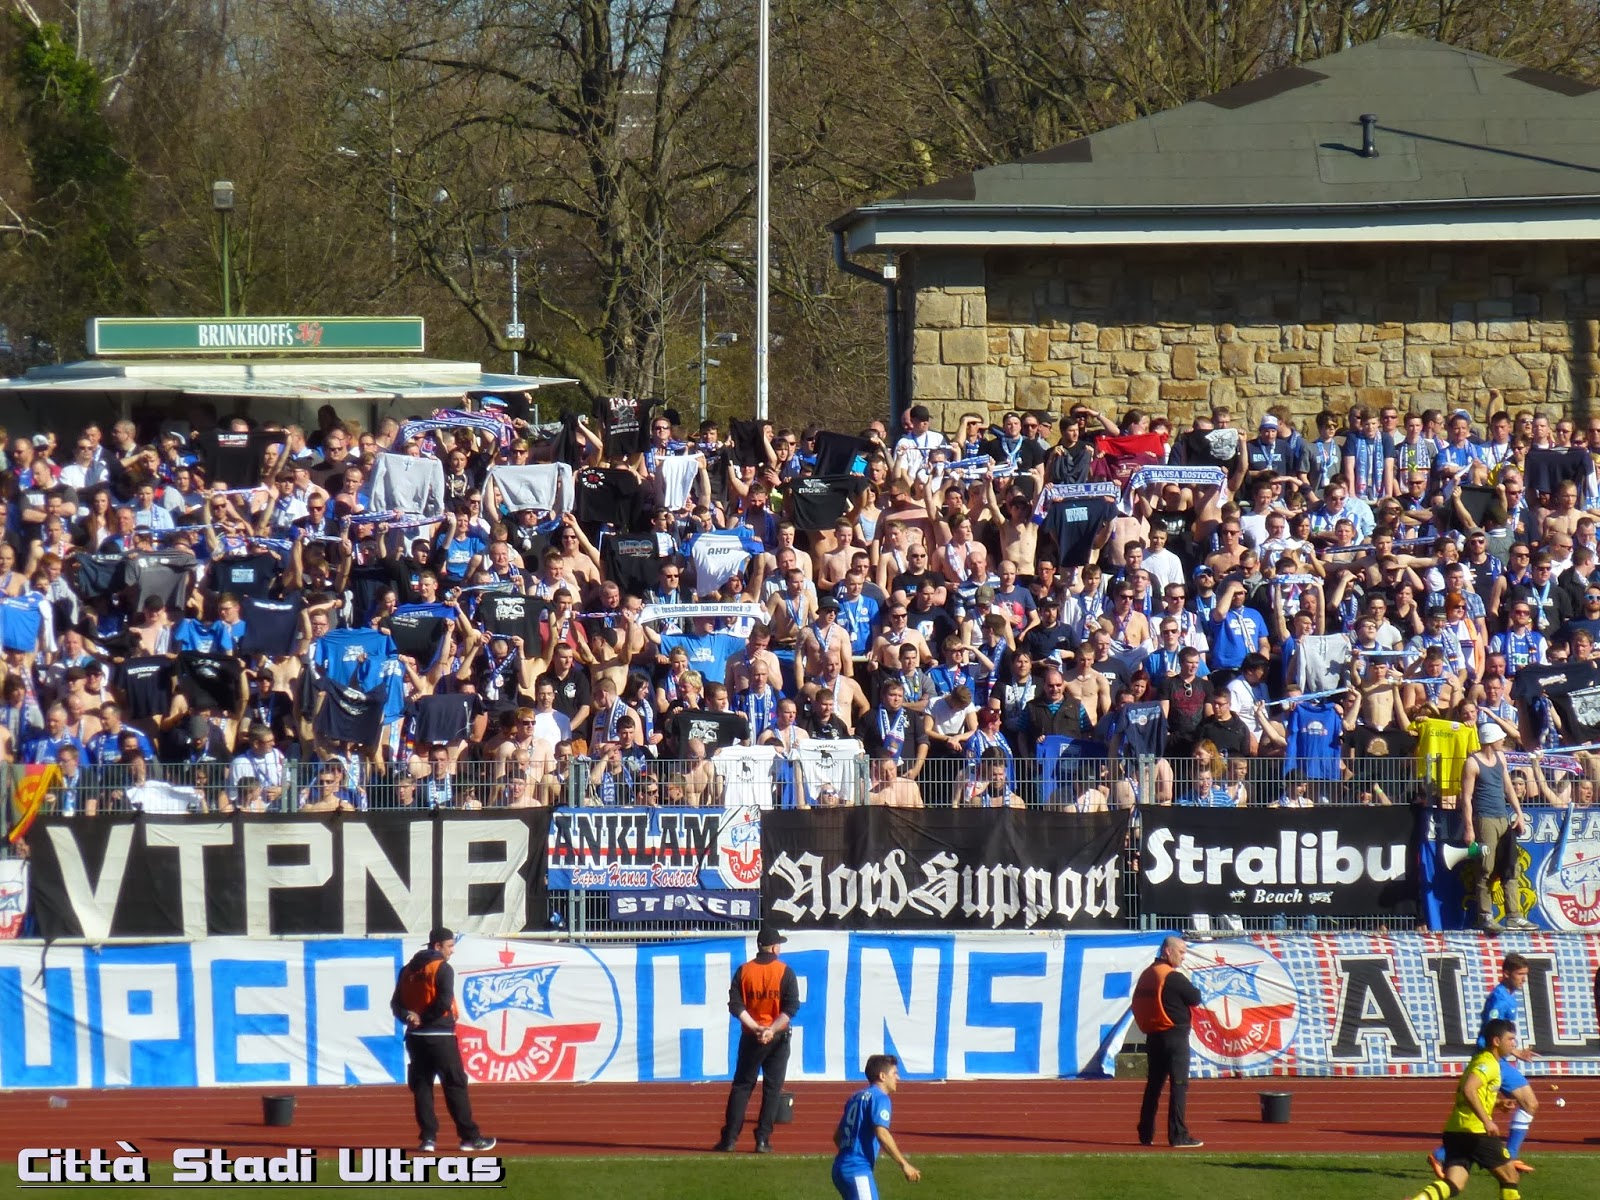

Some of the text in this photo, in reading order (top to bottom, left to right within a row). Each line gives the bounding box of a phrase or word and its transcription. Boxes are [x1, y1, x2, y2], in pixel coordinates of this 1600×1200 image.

[1050, 485, 1085, 496] ANSA
[1151, 471, 1180, 479] HANSA
[1181, 471, 1218, 480] ROSTOCK
[549, 813, 721, 870] ANKLAM
[1145, 827, 1407, 885] Stralibu
[46, 818, 530, 938] VTPNB
[572, 861, 699, 888] Support Hansa Rostock
[908, 850, 1120, 928] Support
[1253, 888, 1304, 904] Beach
[1222, 1022, 1266, 1052] HANSA
[488, 1035, 557, 1081] HANSA
